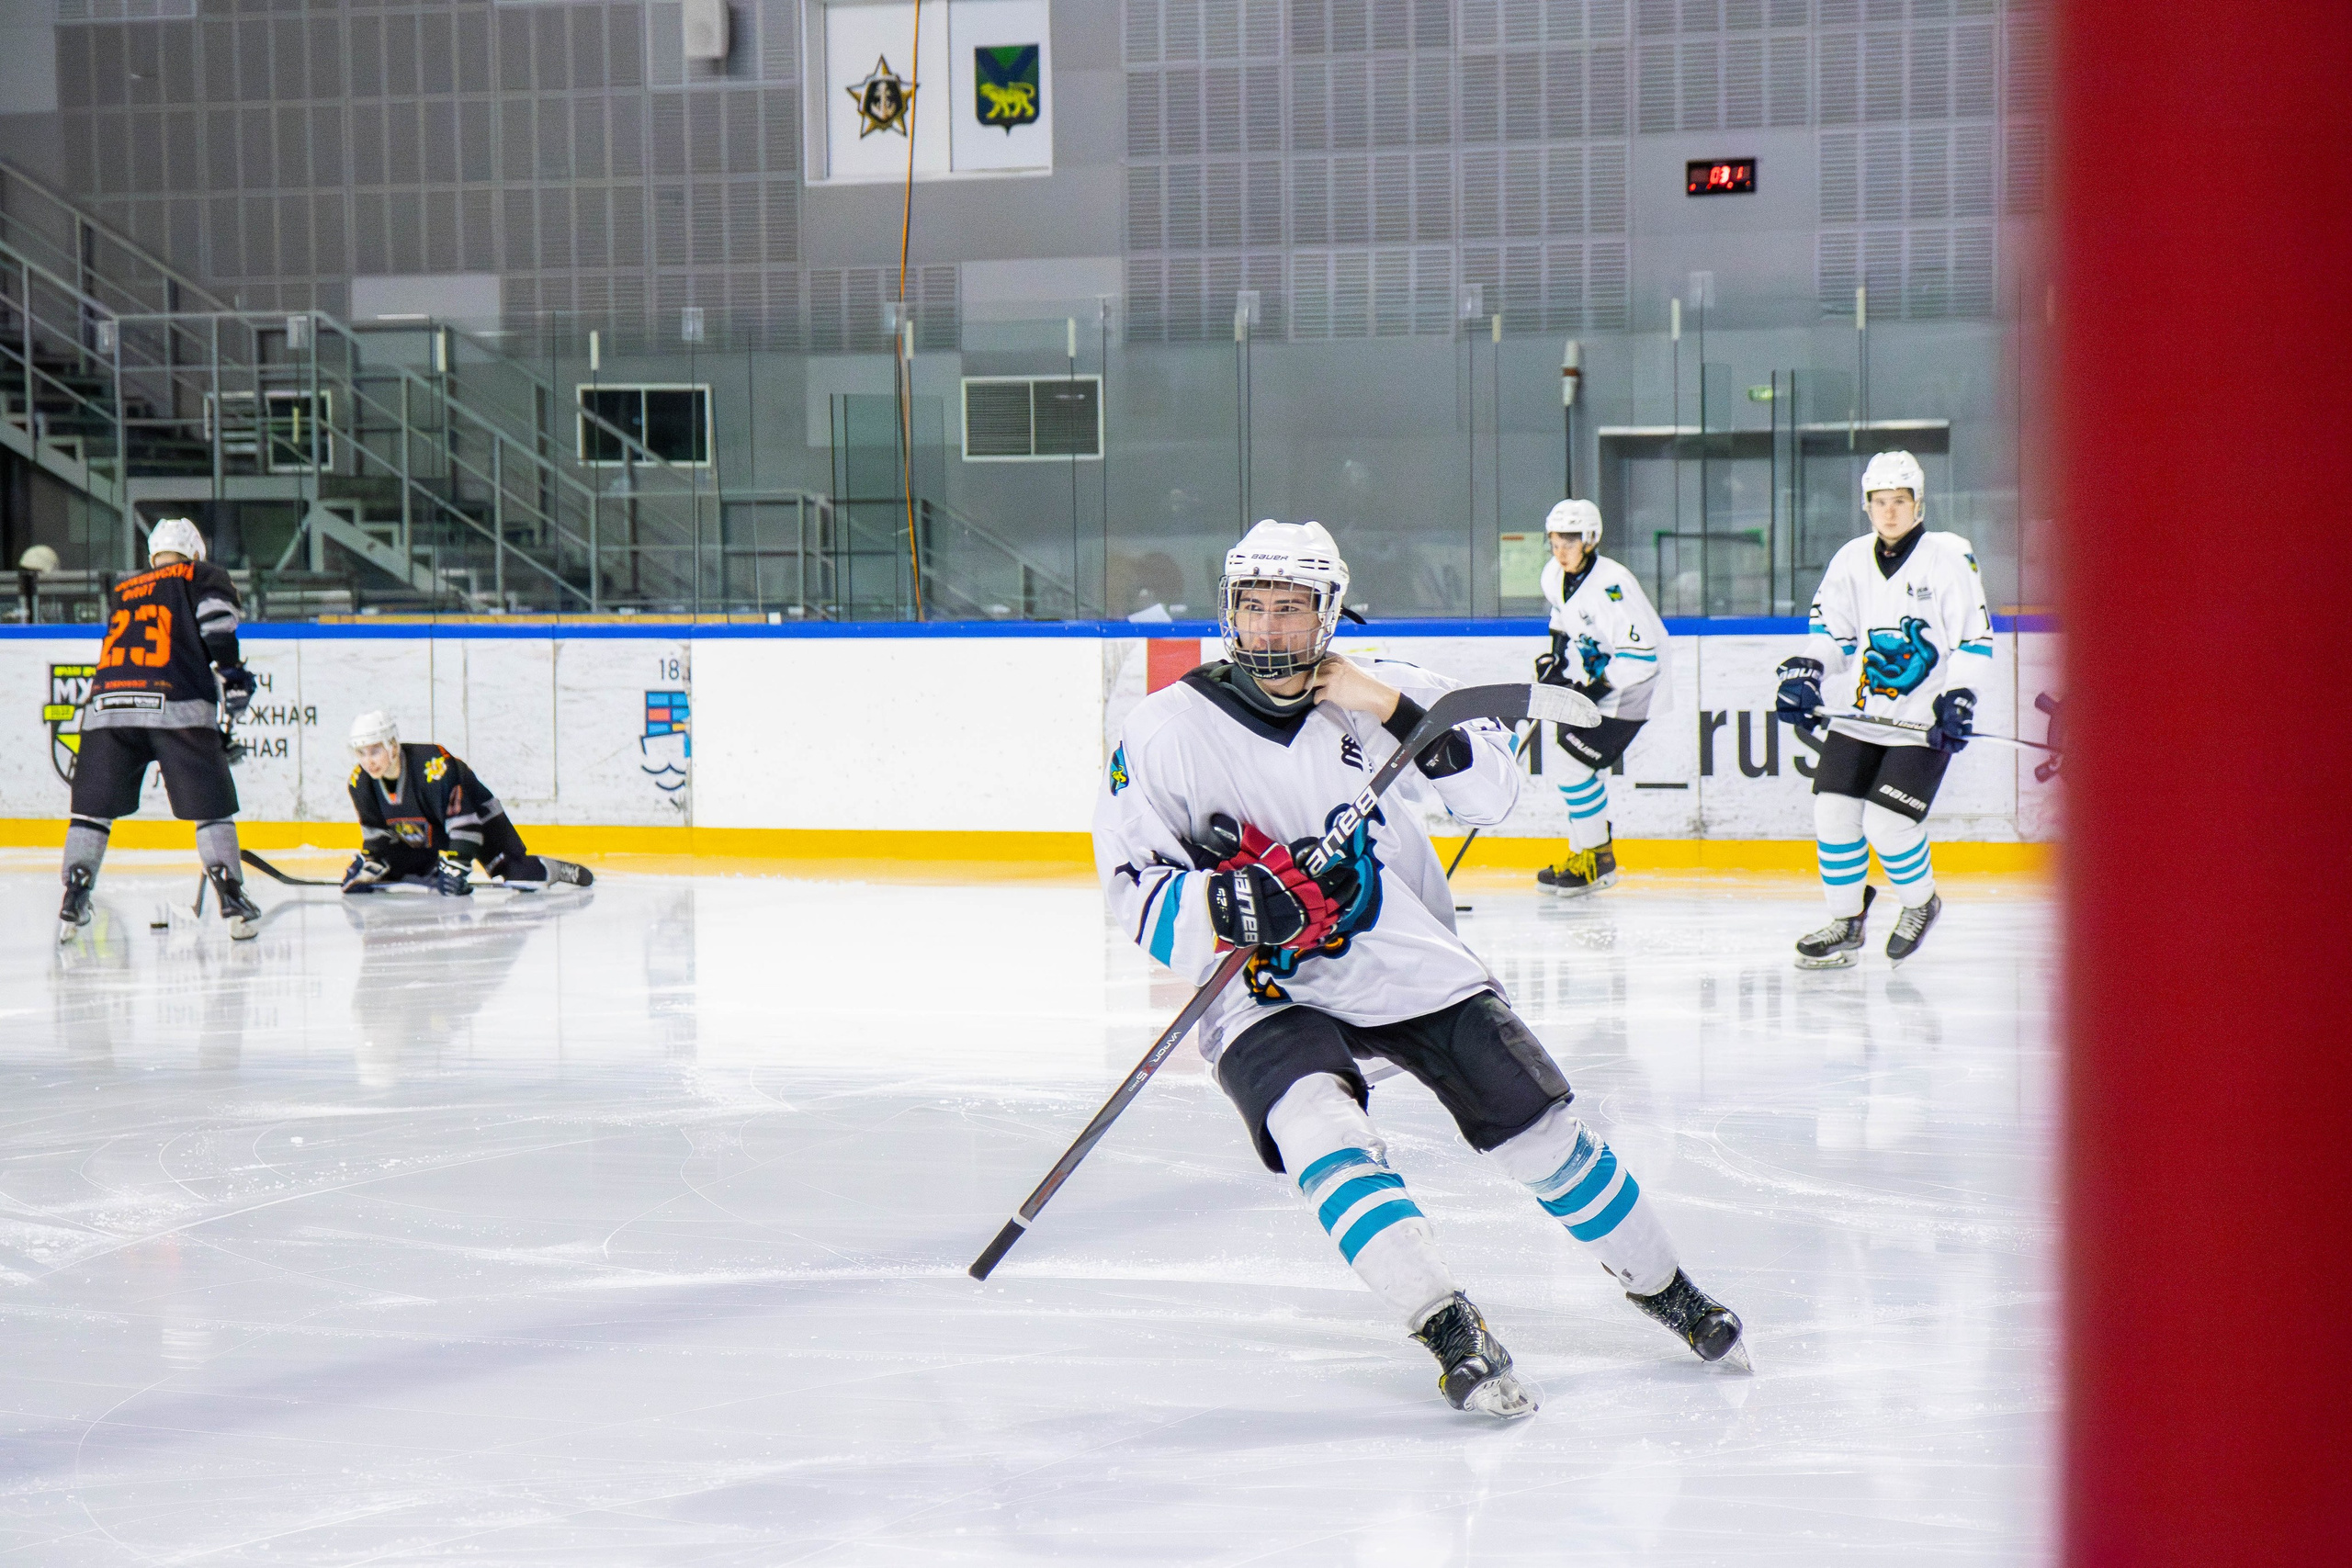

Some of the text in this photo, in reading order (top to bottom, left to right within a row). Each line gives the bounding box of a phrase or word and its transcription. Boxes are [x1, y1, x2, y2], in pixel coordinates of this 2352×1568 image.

[1250, 553, 1289, 561] BAUER
[96, 604, 172, 670] 23
[1629, 625, 1640, 642] 6
[243, 738, 288, 758] НАЯ
[1879, 784, 1928, 811] BAUER
[1306, 784, 1378, 876] BAUE
[1150, 1031, 1182, 1064] VAPOR
